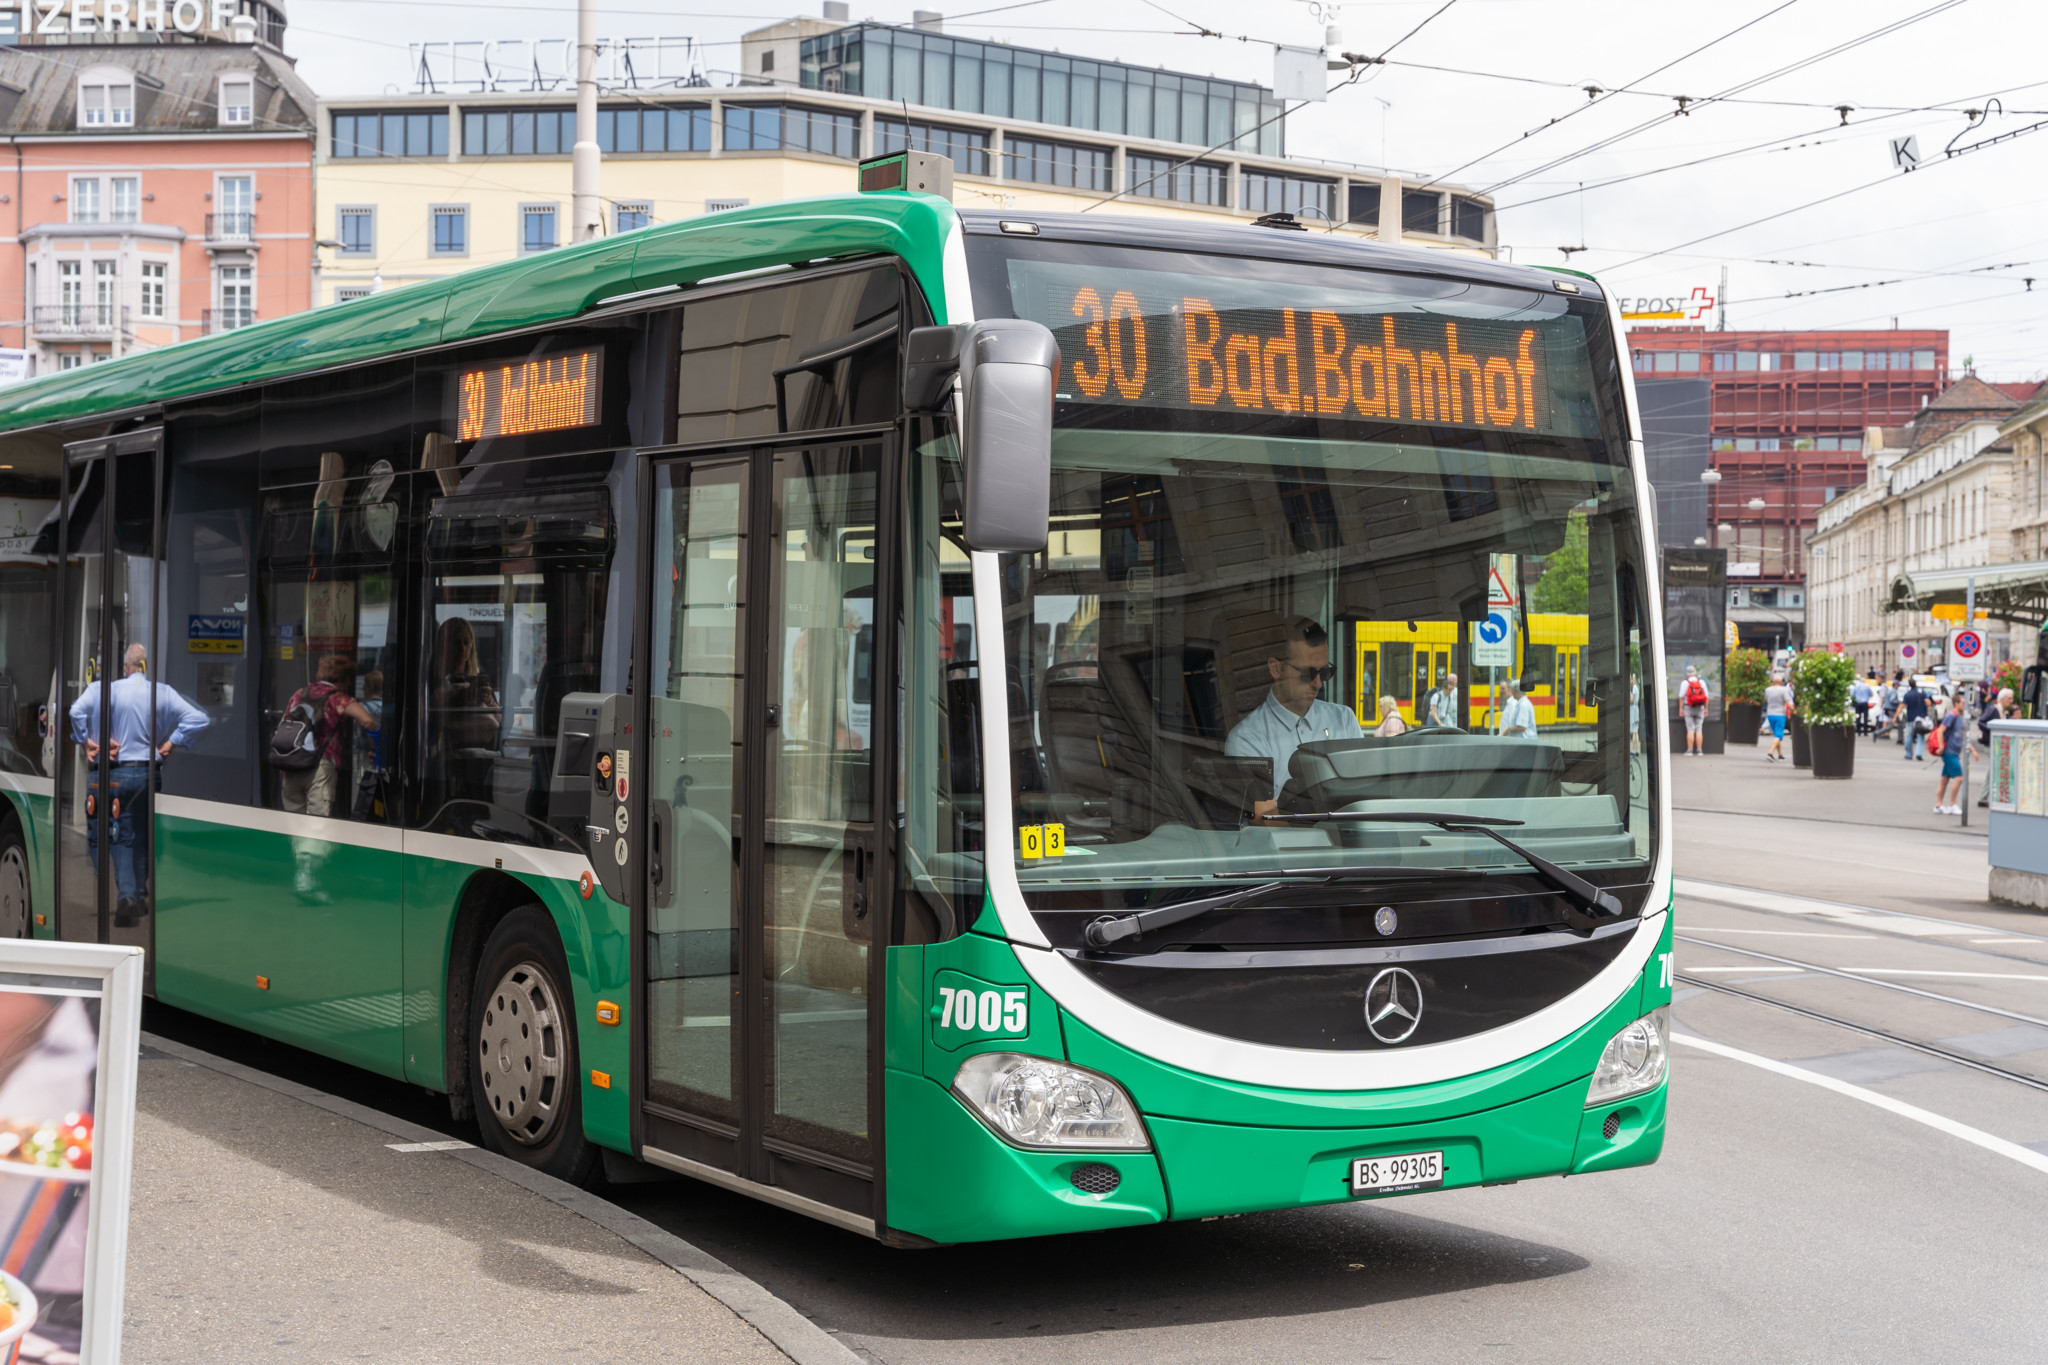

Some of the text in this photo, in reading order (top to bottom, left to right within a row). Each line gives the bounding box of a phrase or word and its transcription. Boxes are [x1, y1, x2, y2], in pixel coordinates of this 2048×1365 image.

[1894, 137, 1917, 165] K
[1635, 298, 1687, 314] POST
[1072, 287, 1536, 429] 30 Bad.Bahnhof
[462, 371, 486, 439] 30
[1028, 833, 1059, 850] 0 3
[940, 987, 1027, 1033] 7005
